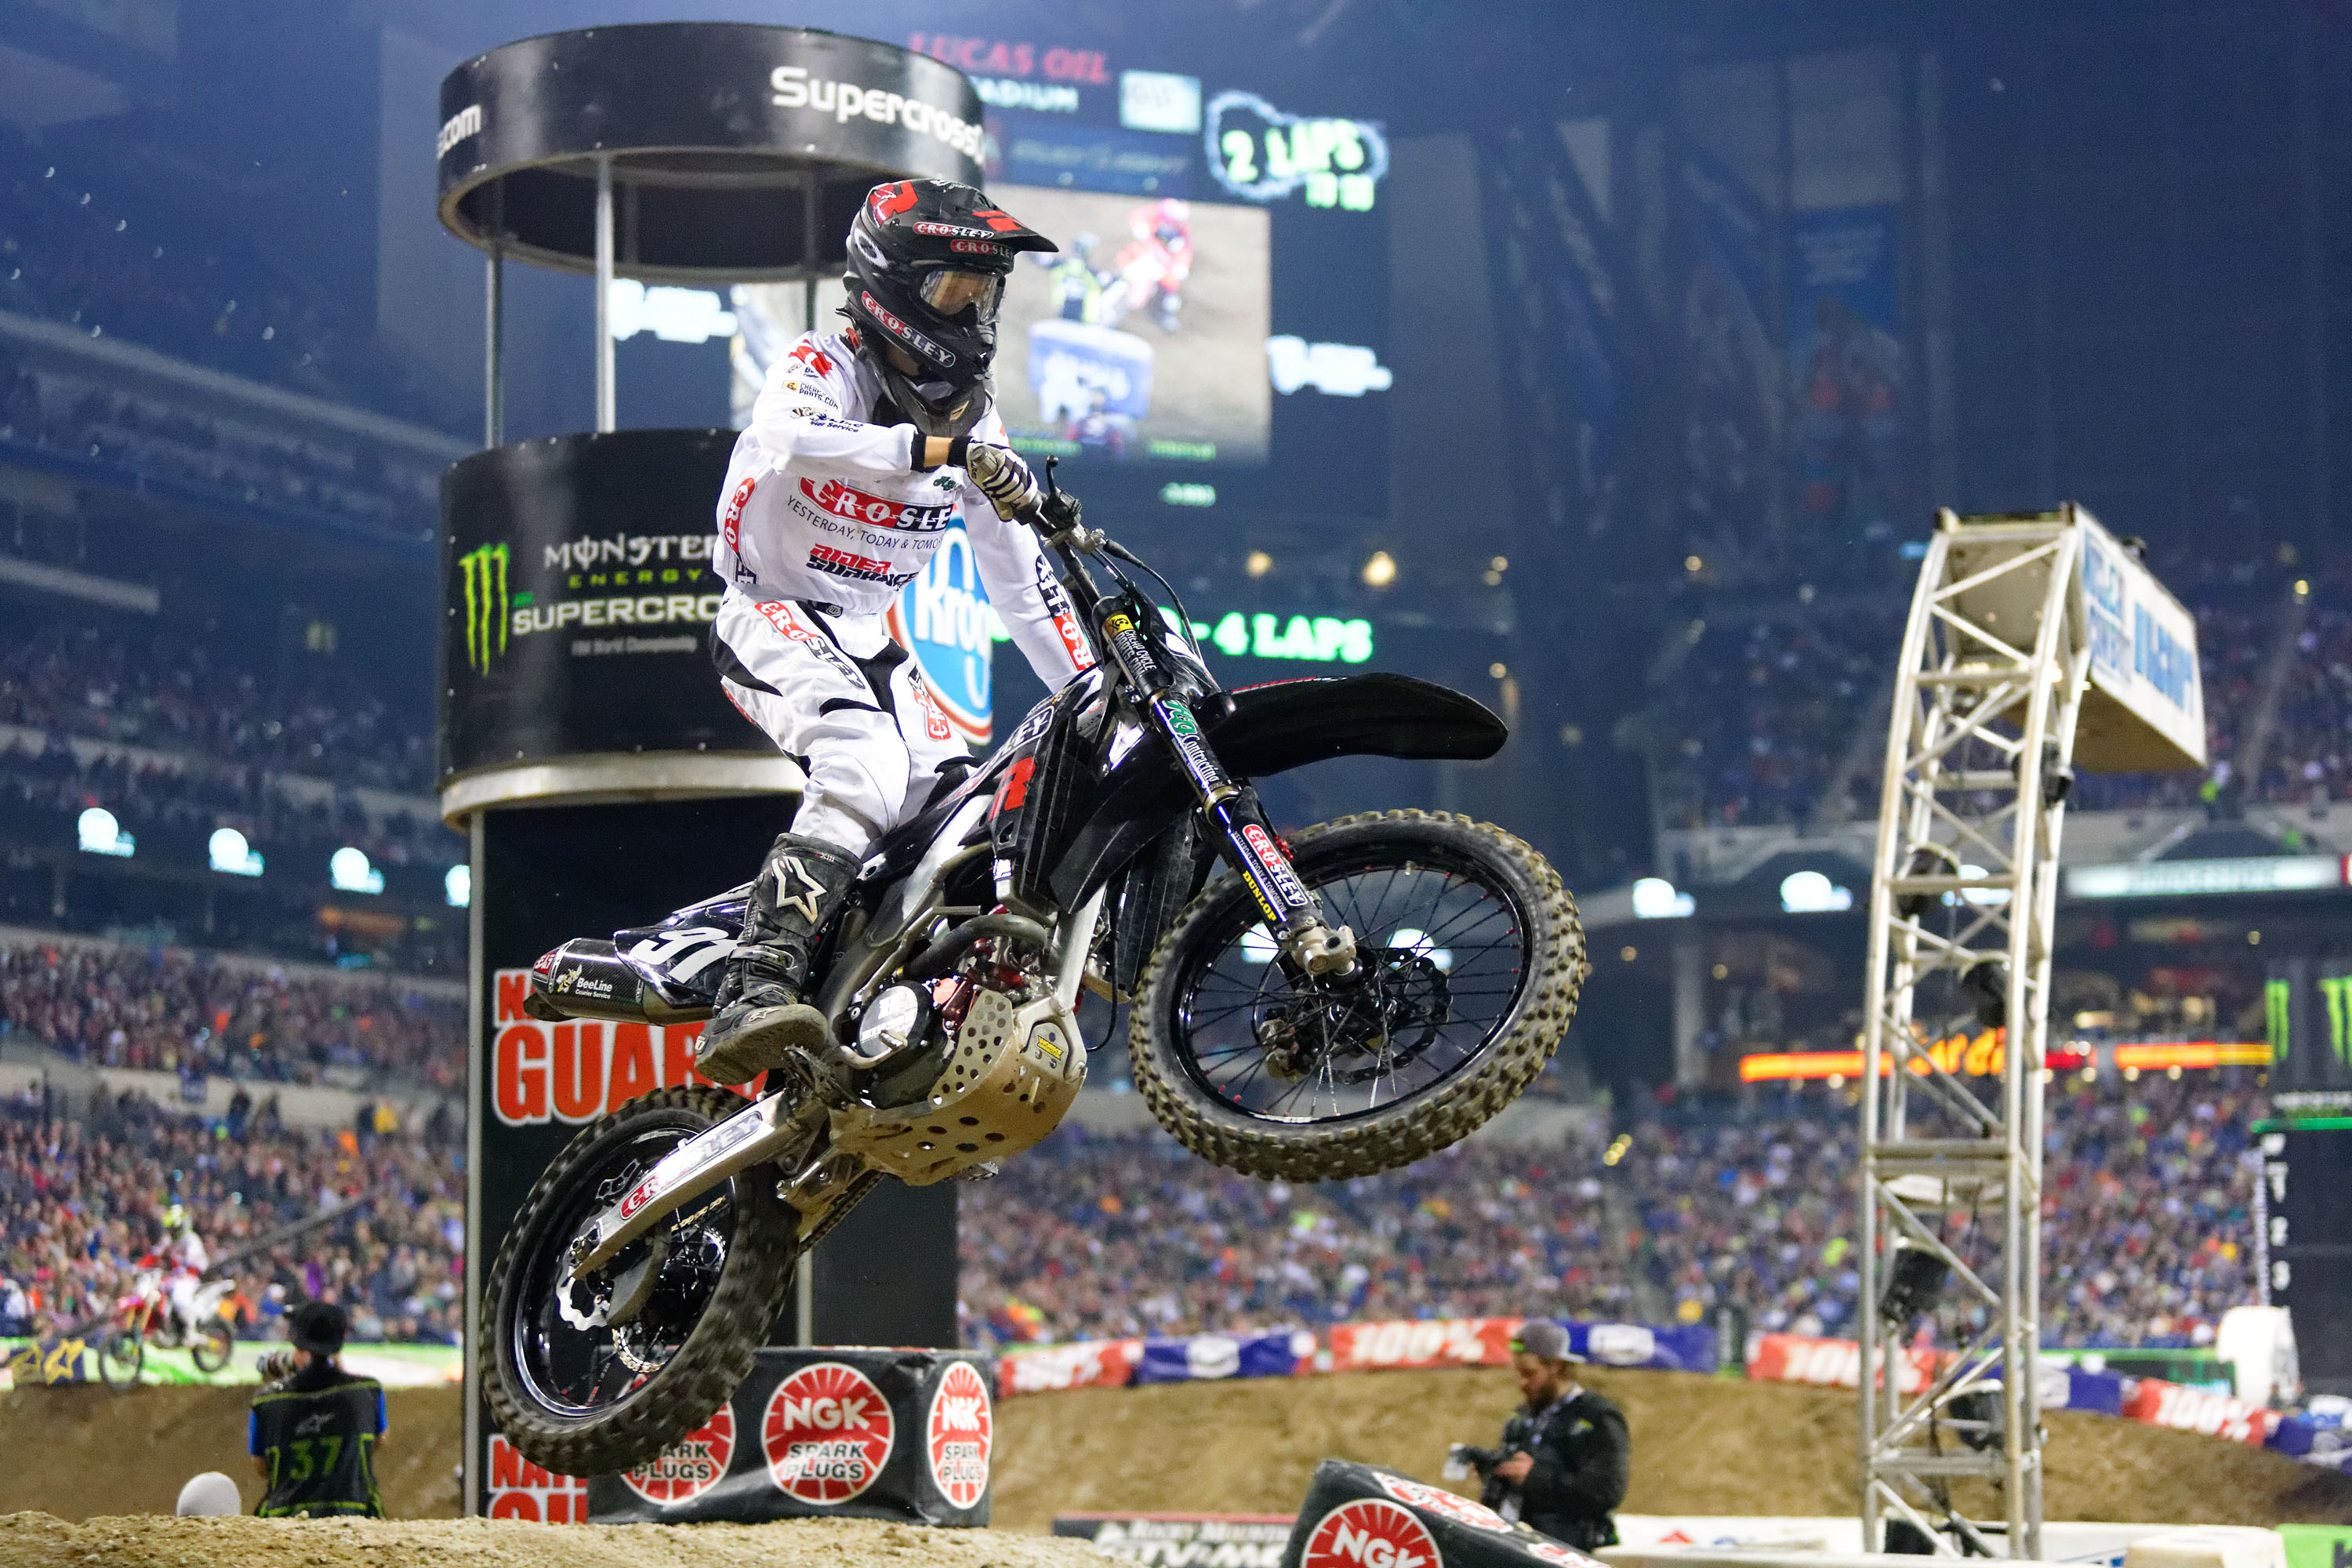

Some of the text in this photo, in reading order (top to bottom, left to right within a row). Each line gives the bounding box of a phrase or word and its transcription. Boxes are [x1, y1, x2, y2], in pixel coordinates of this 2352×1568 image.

[1044, 45, 1112, 84] OIL
[1223, 130, 1258, 182] 2
[916, 223, 989, 238] CROSLEY
[864, 294, 952, 363] CROSLEY
[811, 477, 953, 531] CROSLE
[860, 530, 900, 549] TODAY
[901, 539, 909, 549] &
[809, 543, 892, 575] RIDER
[568, 568, 702, 590] ENERGY
[1252, 612, 1373, 663] LAPS
[1181, 734, 1220, 782] Contracting
[1247, 828, 1305, 904] CROSLEY
[1242, 869, 1278, 922] DUNLOP
[575, 989, 612, 1000] Courier Service
[576, 977, 613, 992] BeeLine
[784, 1396, 870, 1431] NGK
[942, 1396, 982, 1432] NGK
[289, 1436, 343, 1481] 37
[660, 1442, 710, 1459] ARK
[788, 1443, 864, 1459] SPARK
[943, 1443, 980, 1460] SPARK
[633, 1463, 710, 1479] PLUGS
[786, 1462, 863, 1479] PLUGS
[942, 1465, 982, 1481] PLUGS
